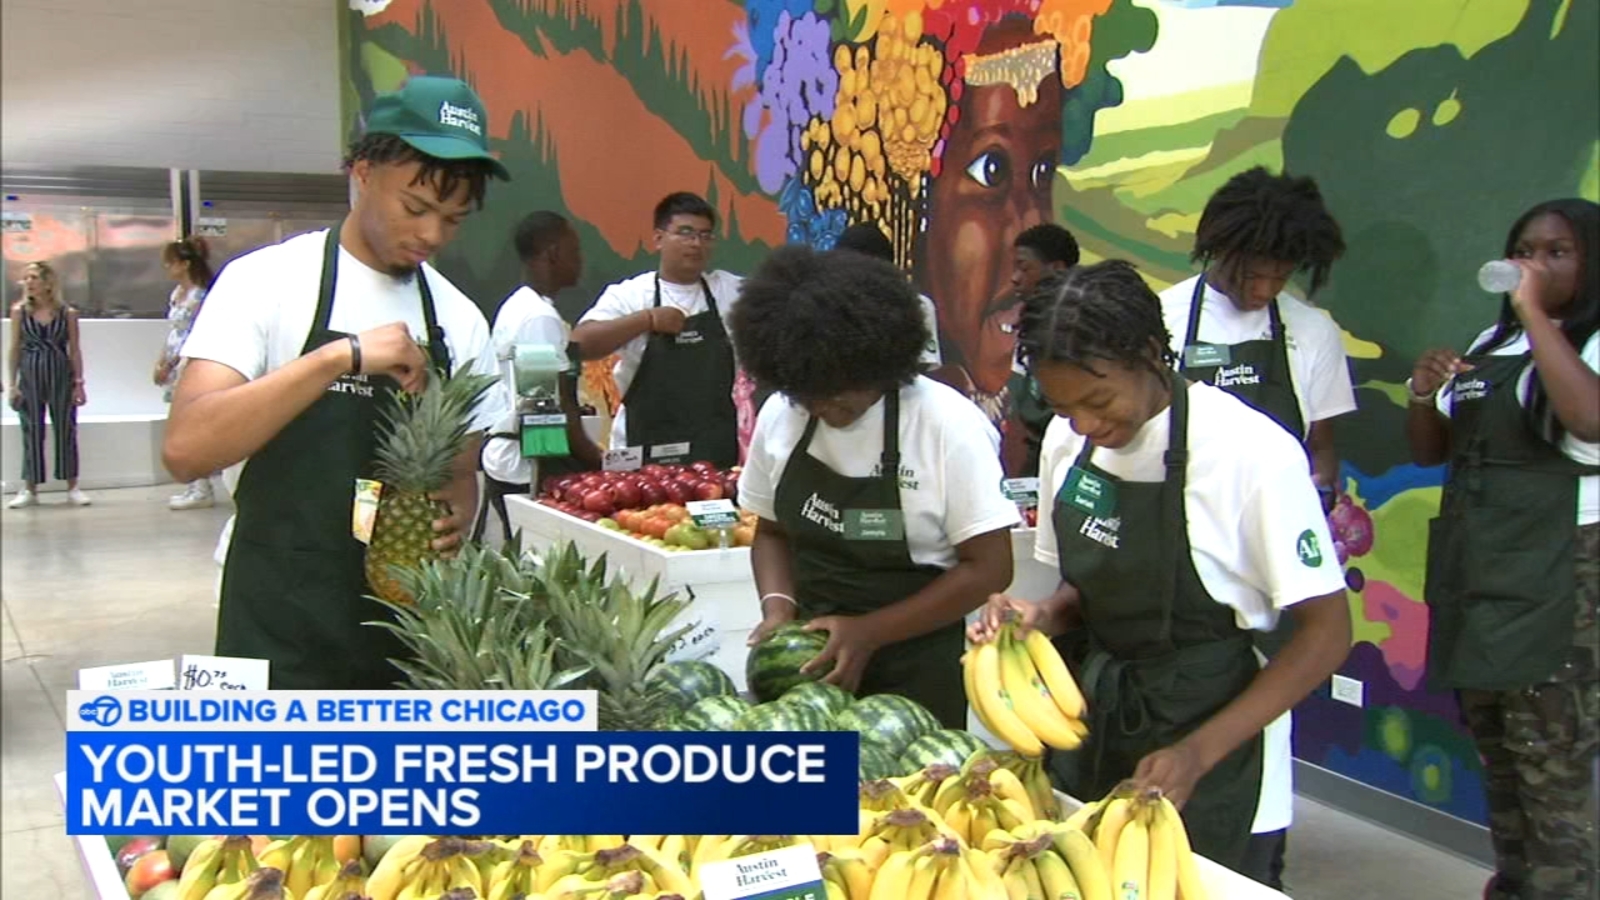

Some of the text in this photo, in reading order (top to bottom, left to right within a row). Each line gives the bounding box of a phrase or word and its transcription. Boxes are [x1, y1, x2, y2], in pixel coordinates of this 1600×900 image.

[440, 101, 477, 121] Austin
[440, 111, 481, 135] Harvest
[1215, 373, 1260, 386] Harvest
[1216, 363, 1254, 377] Austin
[327, 380, 374, 397] arvest
[809, 491, 840, 520] Austin
[801, 499, 845, 533] Harvest
[736, 858, 778, 874] Austin
[736, 868, 788, 887] Harvest
